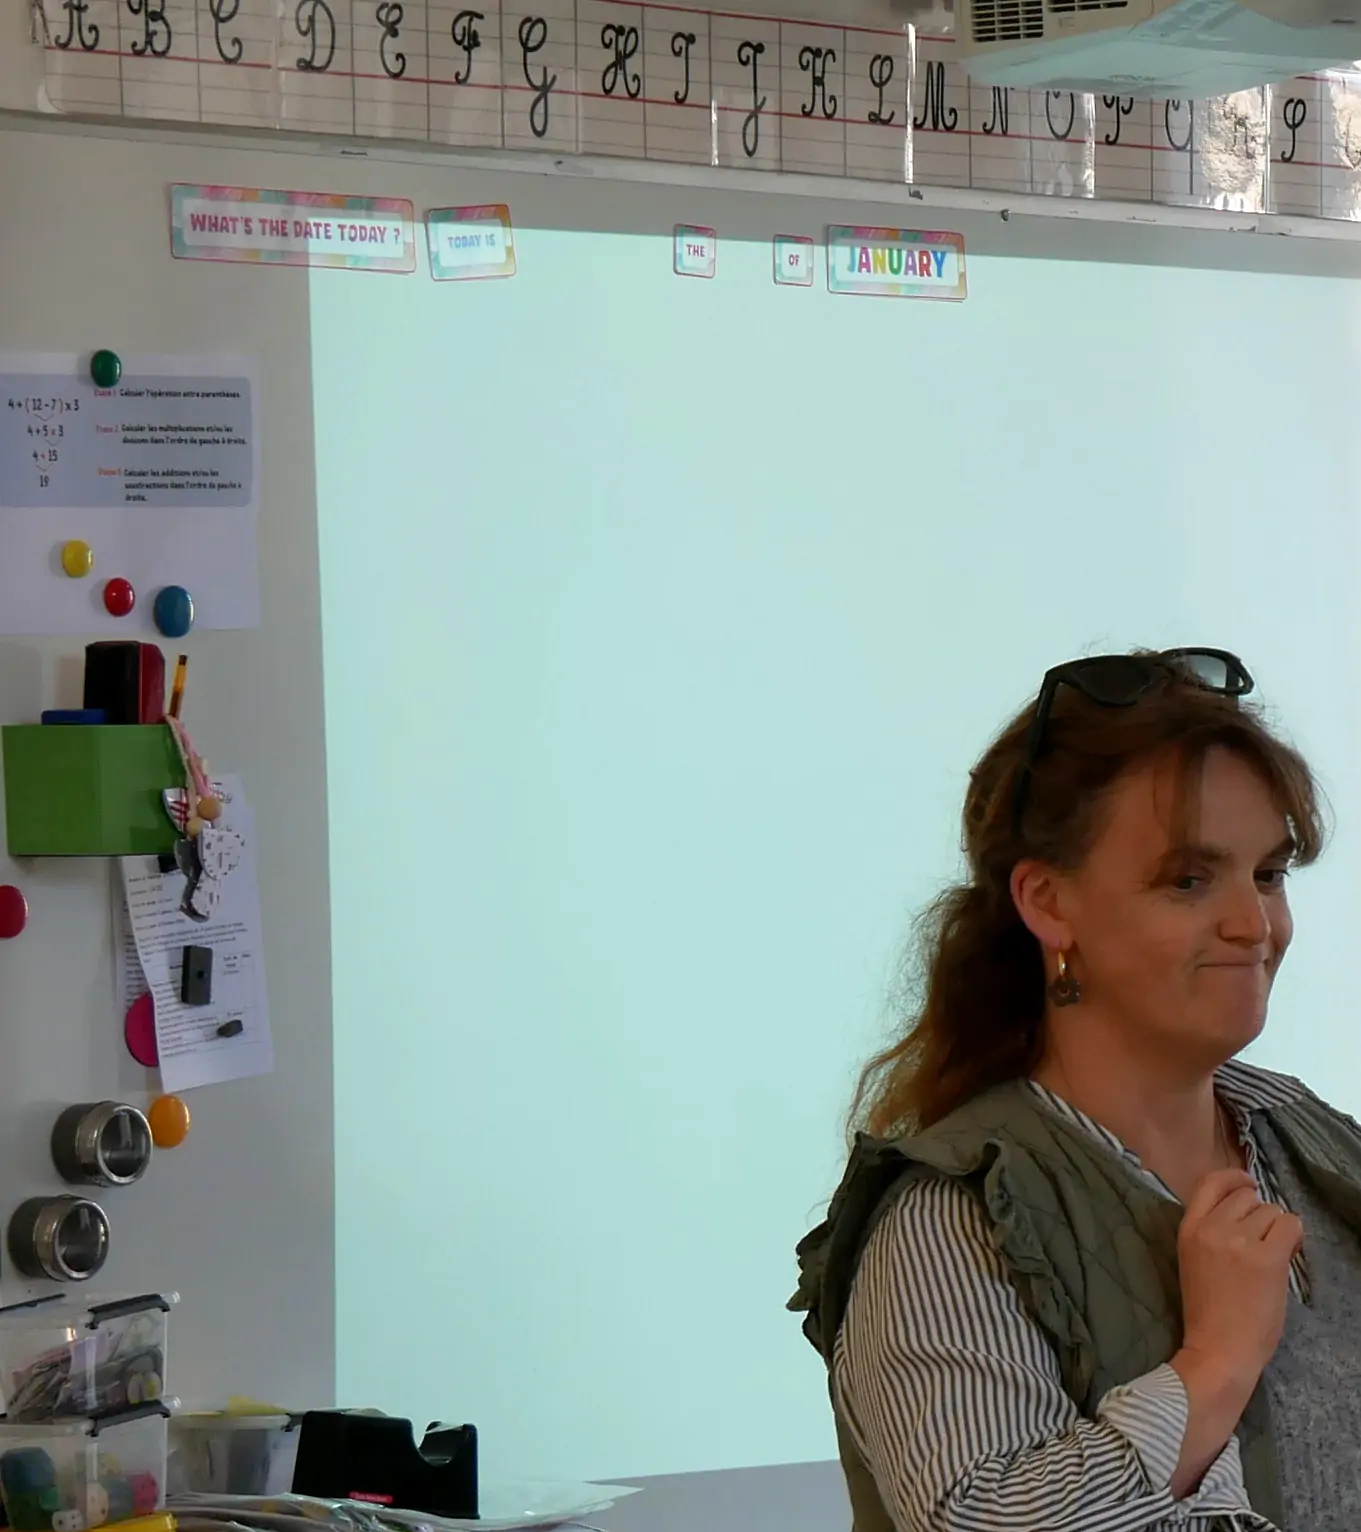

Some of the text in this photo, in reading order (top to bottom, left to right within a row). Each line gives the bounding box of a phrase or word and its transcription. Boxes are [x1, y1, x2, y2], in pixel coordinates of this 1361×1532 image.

[295, 0, 335, 71] D
[376, 3, 405, 79] E
[452, 11, 484, 84] F
[519, 17, 557, 138] G
[601, 24, 641, 98] H
[913, 61, 958, 132] M
[190, 213, 253, 235] WHAT'S
[258, 218, 288, 237] THE
[293, 220, 332, 241] DATE
[339, 225, 387, 245] TODAY
[447, 233, 496, 250] TODAY IS
[686, 243, 707, 258] THE
[788, 253, 801, 266] OF
[847, 245, 948, 278] JANUARY
